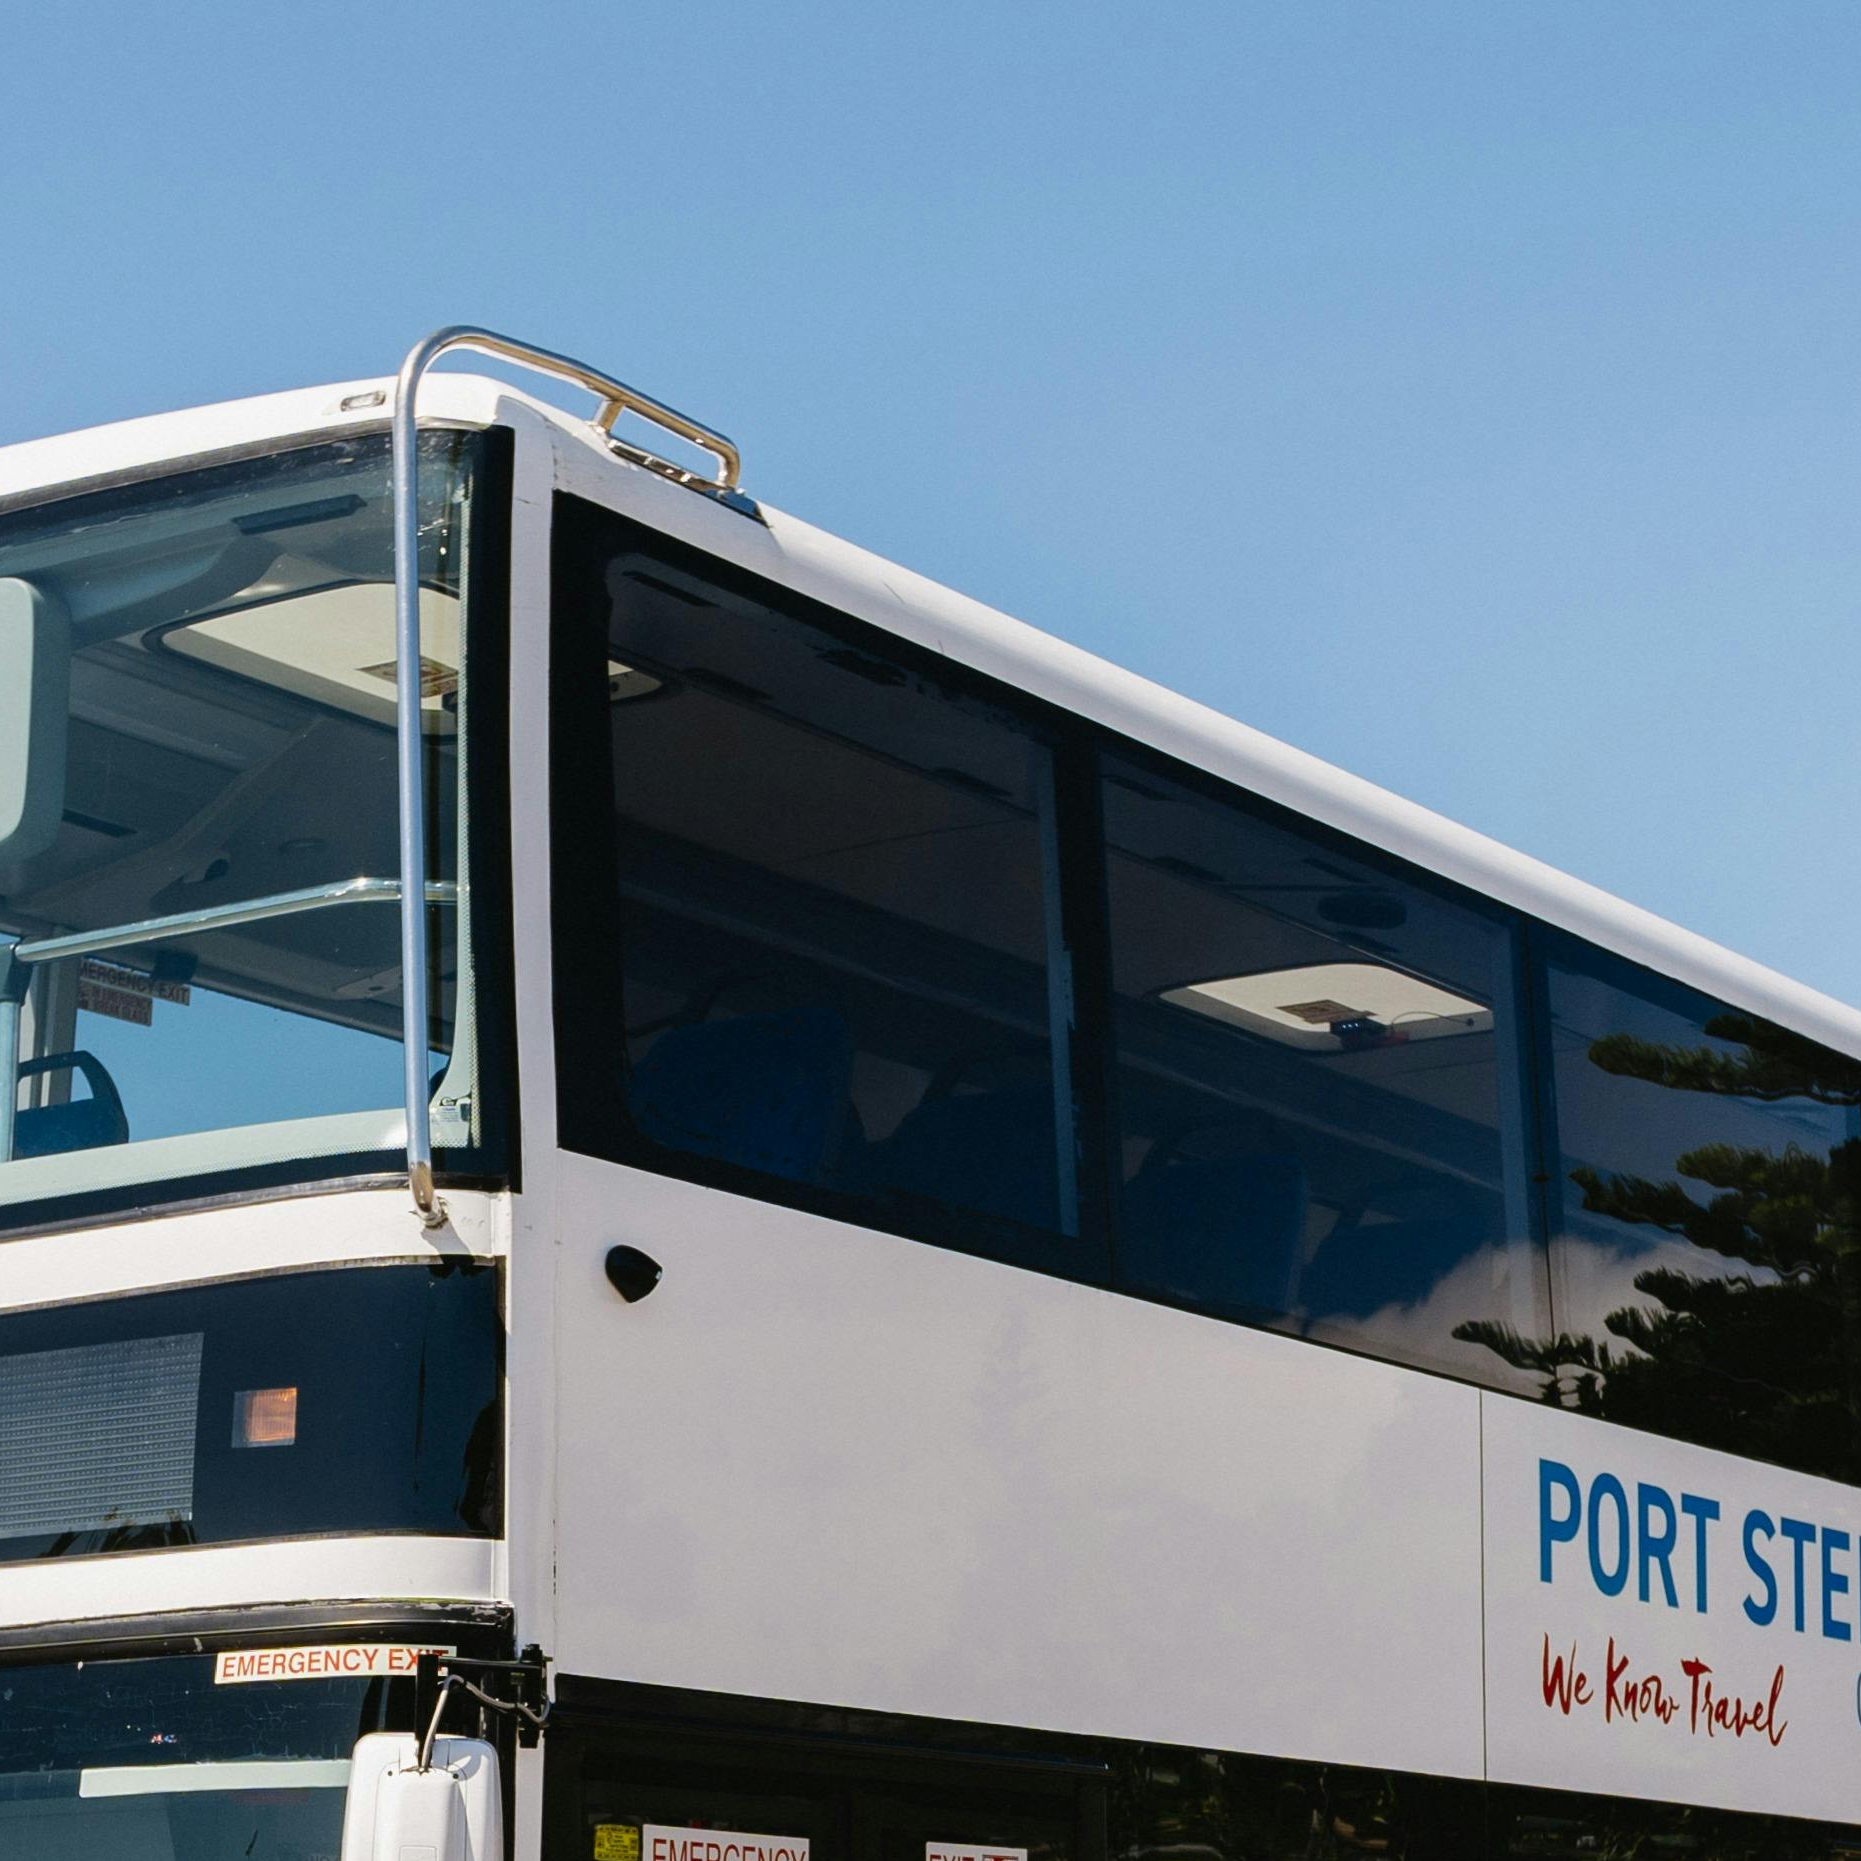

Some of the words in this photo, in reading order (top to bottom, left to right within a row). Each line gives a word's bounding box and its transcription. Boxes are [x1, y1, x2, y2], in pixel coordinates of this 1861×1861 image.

[1539, 1458, 1721, 1614] PORT
[222, 1648, 380, 1679] EMERGENCY
[388, 1647, 450, 1672] EXT
[1542, 1631, 1594, 1716] We
[1605, 1635, 1680, 1725] Know
[1680, 1656, 1789, 1747] Travel
